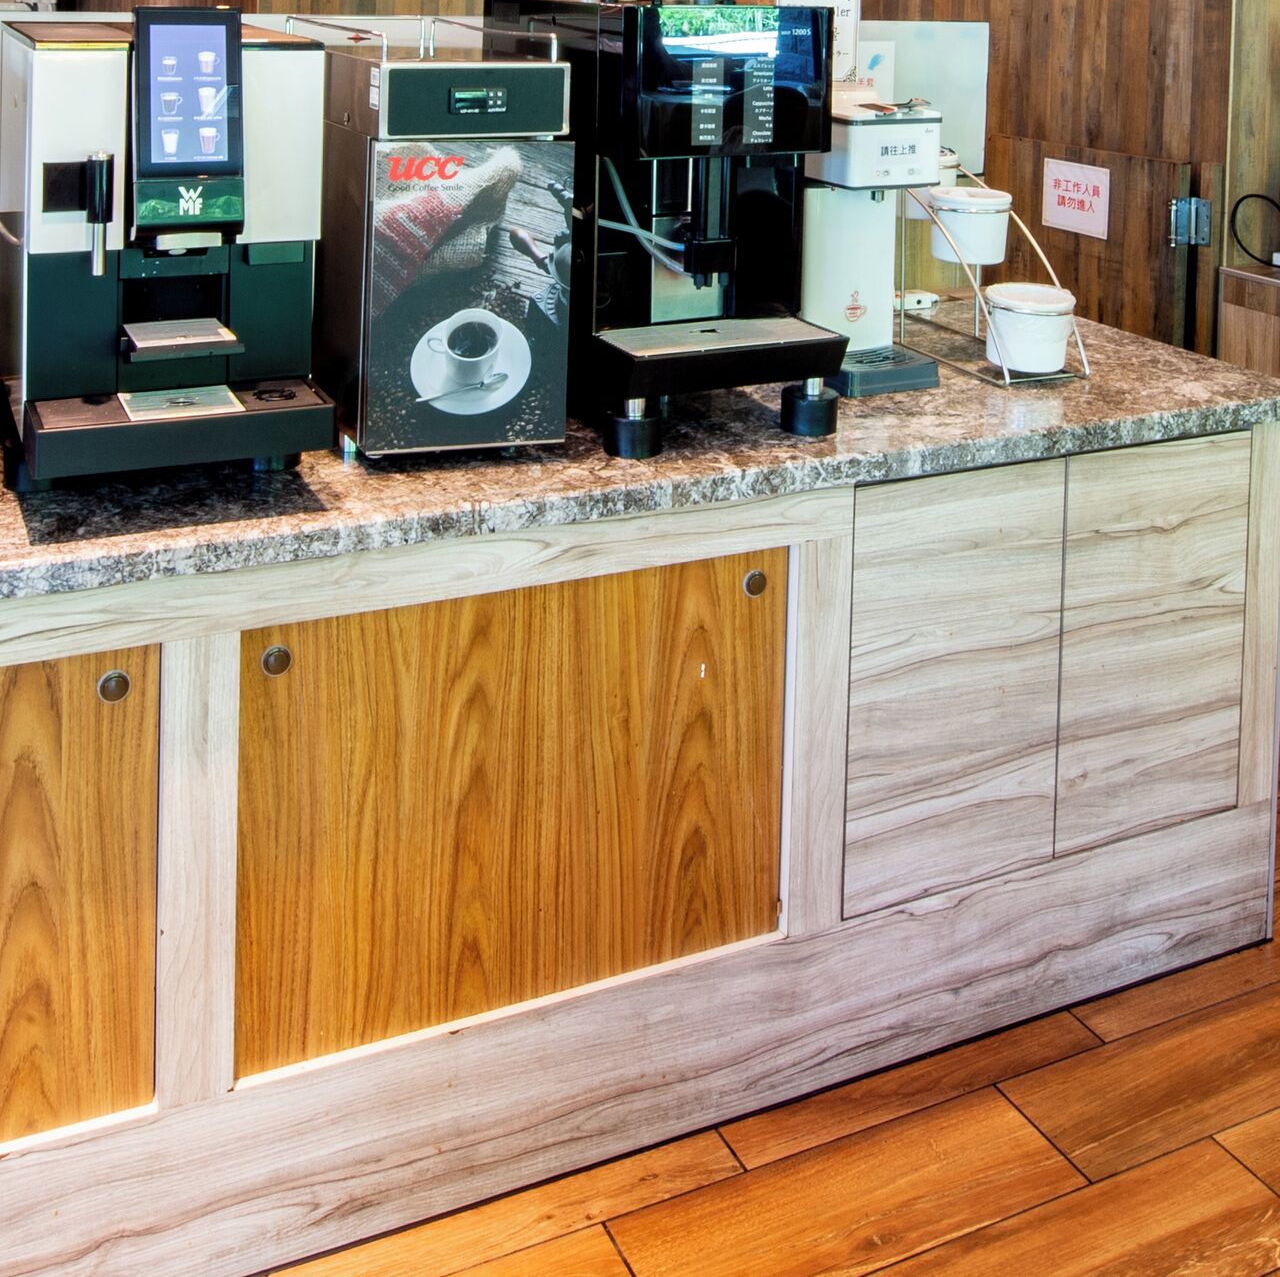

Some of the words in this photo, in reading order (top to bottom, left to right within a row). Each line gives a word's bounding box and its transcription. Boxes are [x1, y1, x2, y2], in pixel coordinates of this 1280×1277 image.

[880, 144, 917, 157] 請往上推
[1052, 177, 1101, 199] 非工作人員
[1057, 194, 1096, 214] 請勿進入
